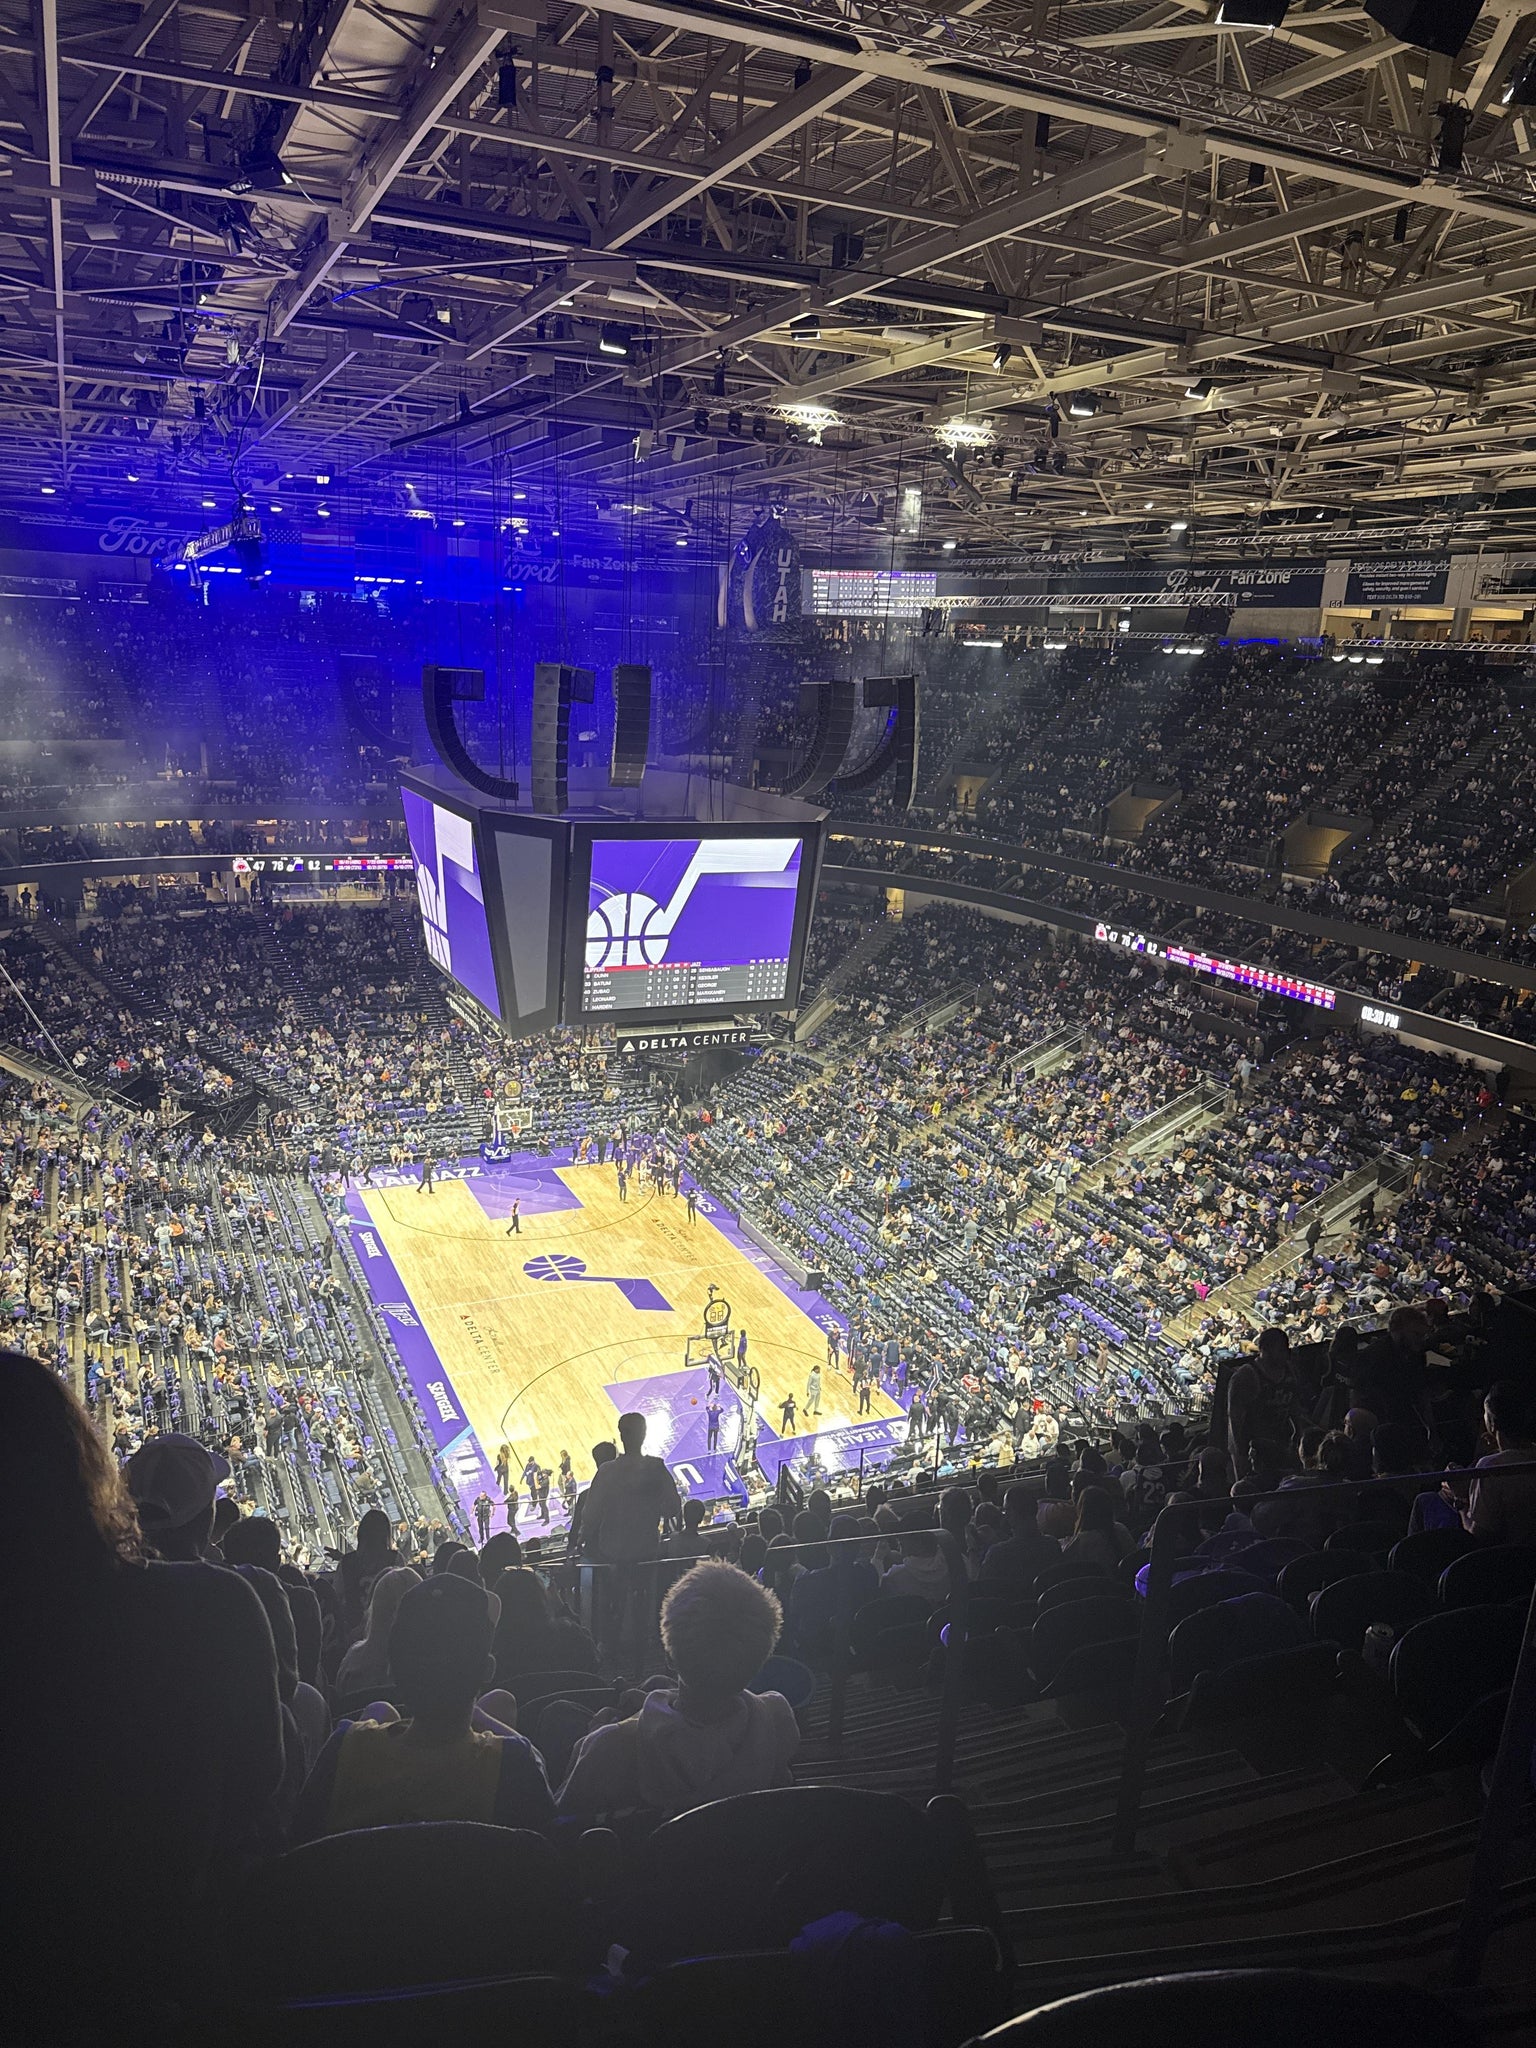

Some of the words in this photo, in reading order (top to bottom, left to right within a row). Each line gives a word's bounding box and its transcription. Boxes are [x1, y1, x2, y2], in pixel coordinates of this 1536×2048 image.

[573, 554, 600, 569] Fan
[602, 557, 638, 573] Zone
[773, 549, 792, 622] UTAH
[1230, 571, 1254, 585] Fan
[1256, 571, 1291, 585] Zone
[252, 860, 266, 871] 47
[272, 861, 284, 871] 78
[1108, 931, 1118, 943] 47
[1121, 934, 1131, 947] 78
[1383, 1012, 1400, 1029] PM
[639, 1036, 688, 1050] DELTA
[693, 1032, 747, 1046] CENTER
[354, 1174, 420, 1190] UTAH
[430, 1166, 485, 1182] JAZZ
[656, 1222, 678, 1241] DELTA
[358, 1231, 383, 1258] SEATGEEK
[464, 1320, 484, 1345] DELTA
[478, 1344, 501, 1374] CENTER
[426, 1381, 460, 1423] SEATGEEK
